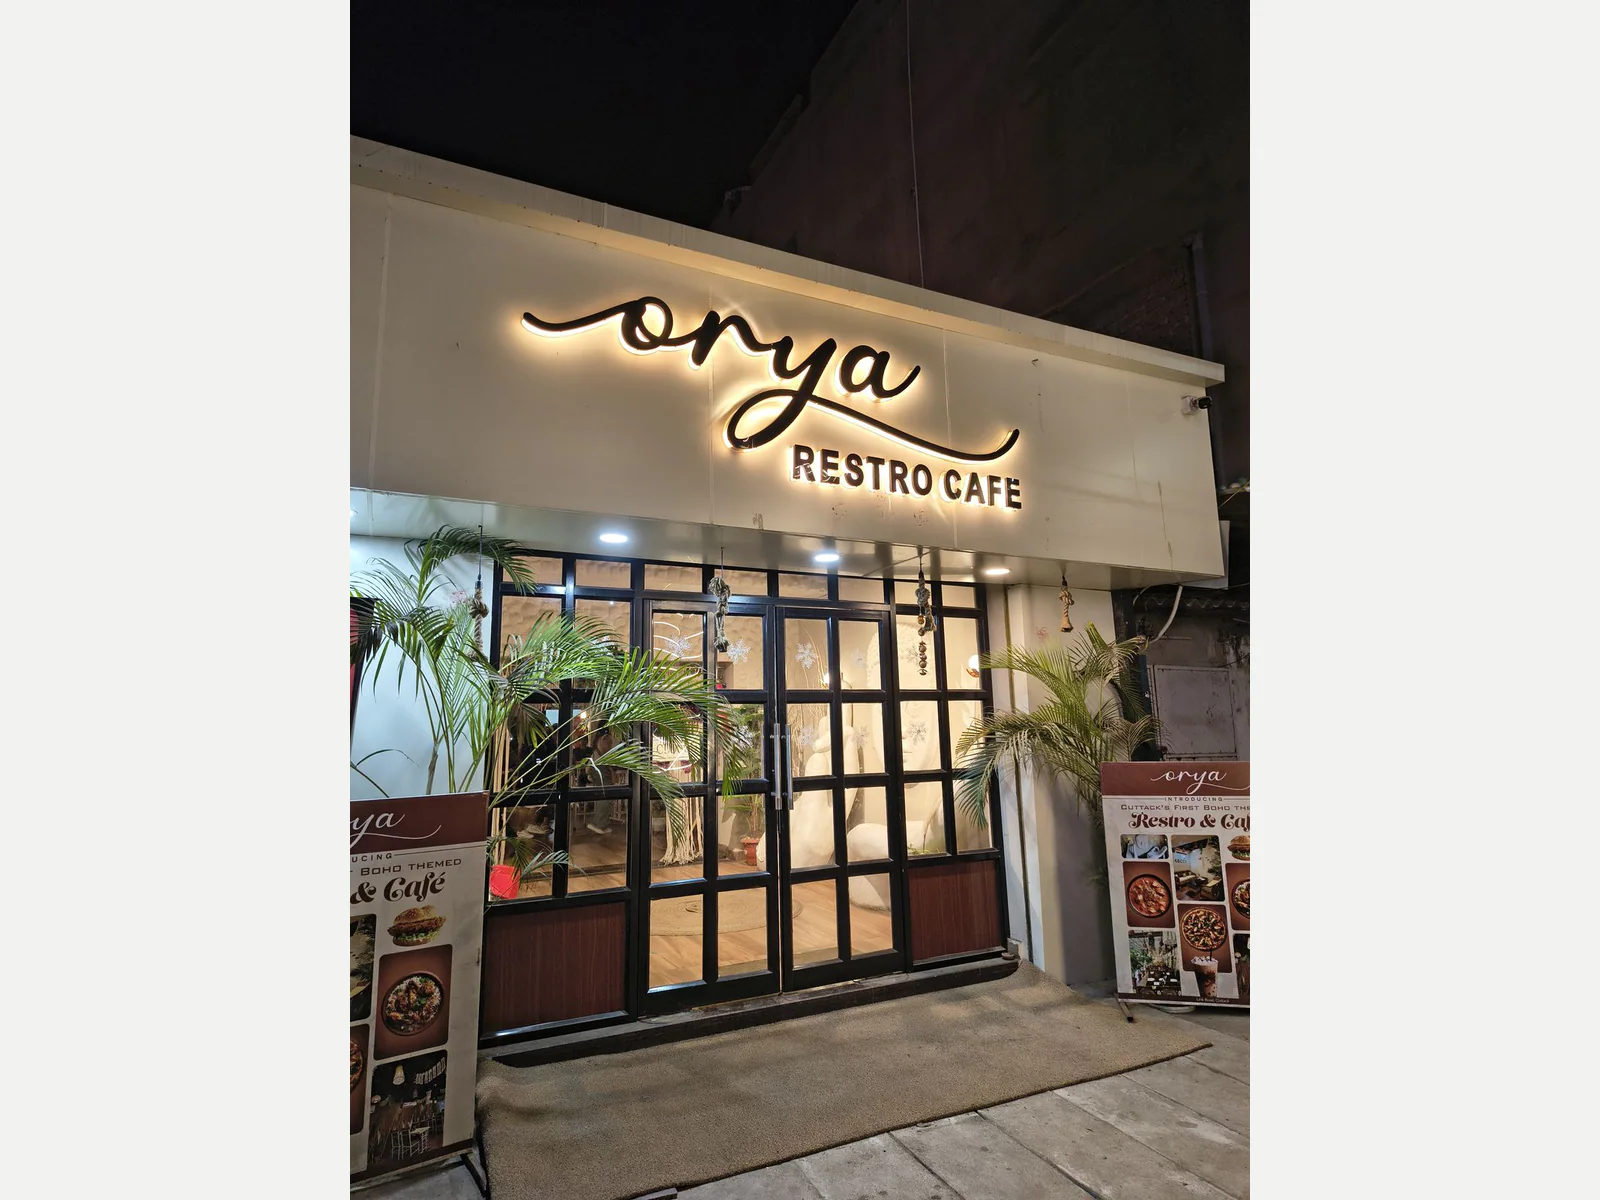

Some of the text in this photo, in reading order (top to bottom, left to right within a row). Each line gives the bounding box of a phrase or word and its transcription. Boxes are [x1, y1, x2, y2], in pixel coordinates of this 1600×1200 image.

[521, 296, 1020, 462] orya
[792, 444, 1022, 511] RESTRO CAFE
[1150, 770, 1250, 795] orya
[1128, 812, 1196, 829] Restro
[1200, 813, 1216, 828] &
[360, 858, 462, 876] BOHO THEMED
[350, 871, 446, 905] & Café
